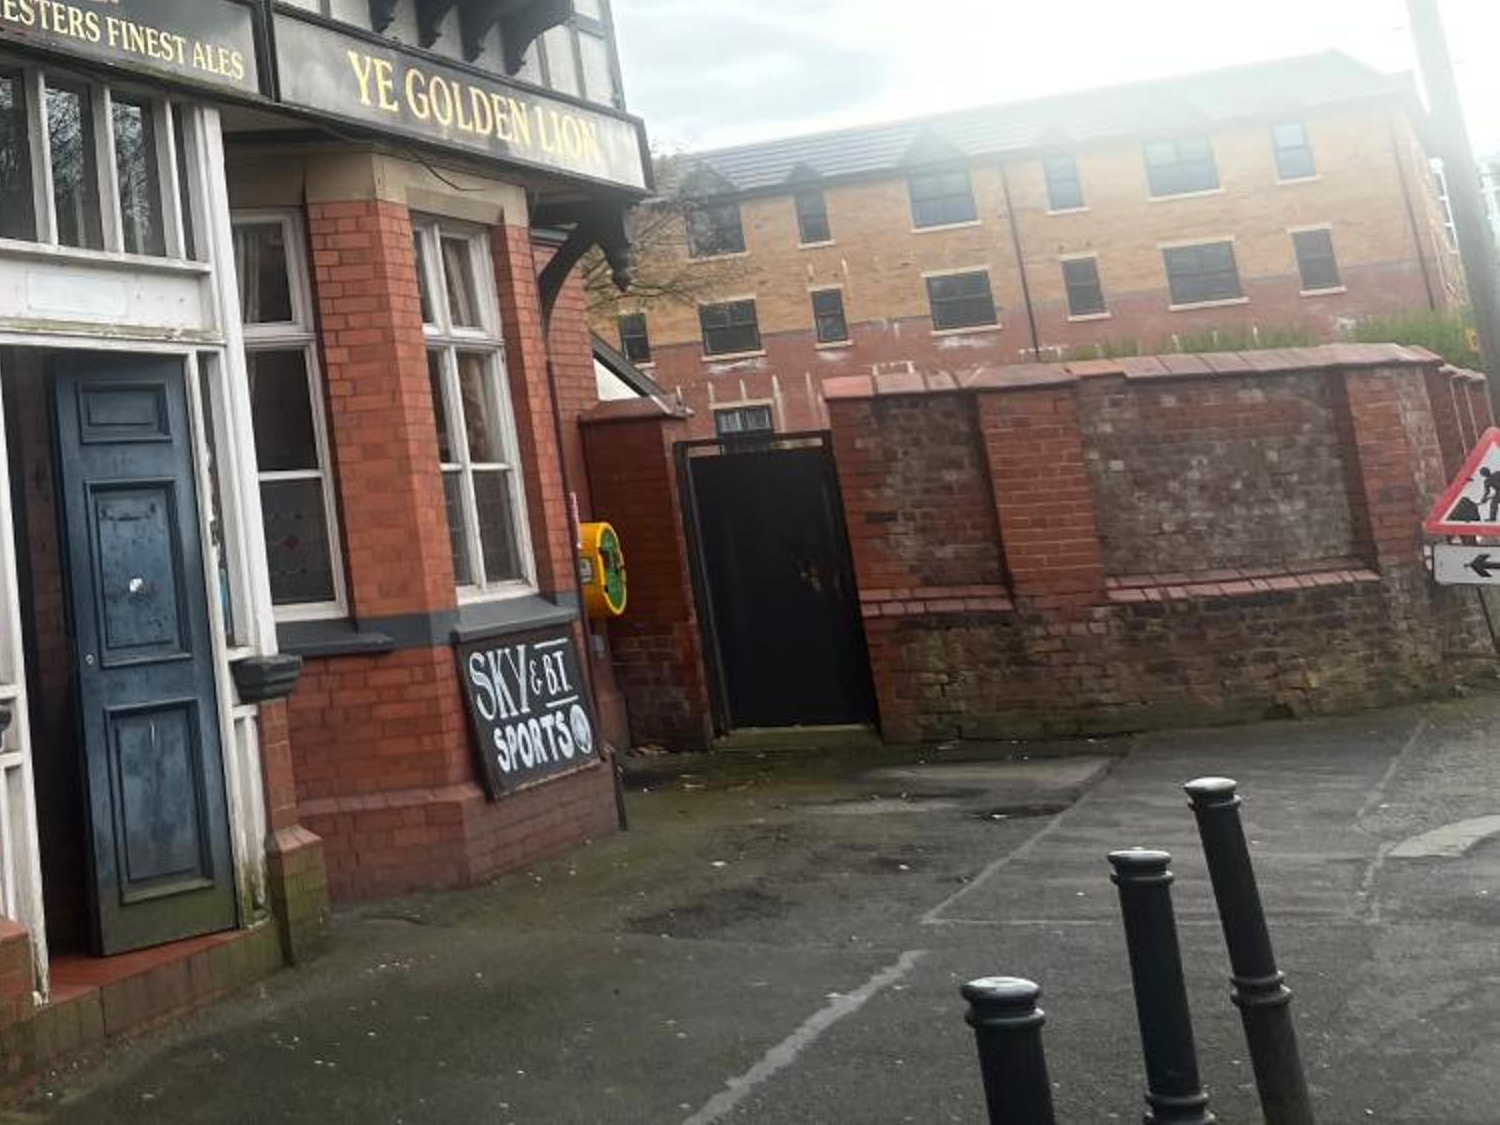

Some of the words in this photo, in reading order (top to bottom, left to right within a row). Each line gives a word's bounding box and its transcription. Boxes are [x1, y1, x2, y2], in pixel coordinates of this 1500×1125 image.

[105, 17, 187, 66] FINEST
[192, 42, 244, 81] ALES
[348, 50, 399, 113] YE
[404, 68, 531, 147] GOLDEN
[536, 106, 599, 161] LION
[469, 644, 530, 720] SKY
[529, 660, 543, 695] &
[494, 710, 575, 772] SPORTS
